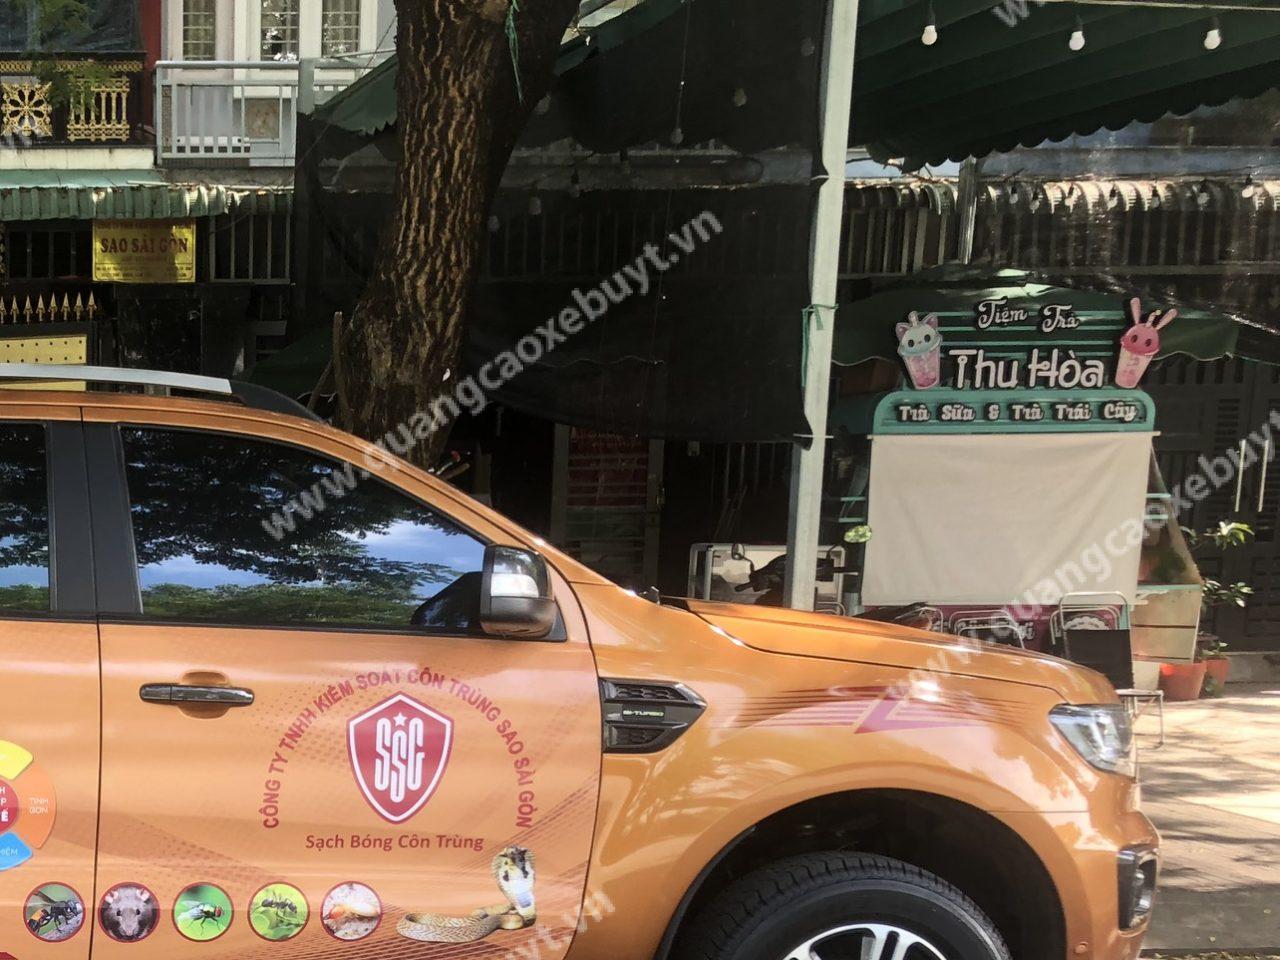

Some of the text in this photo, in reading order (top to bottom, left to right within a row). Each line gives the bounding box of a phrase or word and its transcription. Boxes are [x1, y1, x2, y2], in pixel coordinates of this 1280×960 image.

[100, 238, 128, 254] SAO
[978, 299, 1029, 328] Tiệm
[949, 348, 1104, 388] Thu Hòa
[406, 667, 446, 688] CÔN
[449, 677, 502, 723] TRÙNG
[278, 708, 319, 752] TNHH
[496, 718, 525, 755] SAO
[268, 752, 289, 775] TY
[259, 778, 282, 829] CÔNG
[305, 834, 485, 852] Sạch Bóng Côn Trùng
